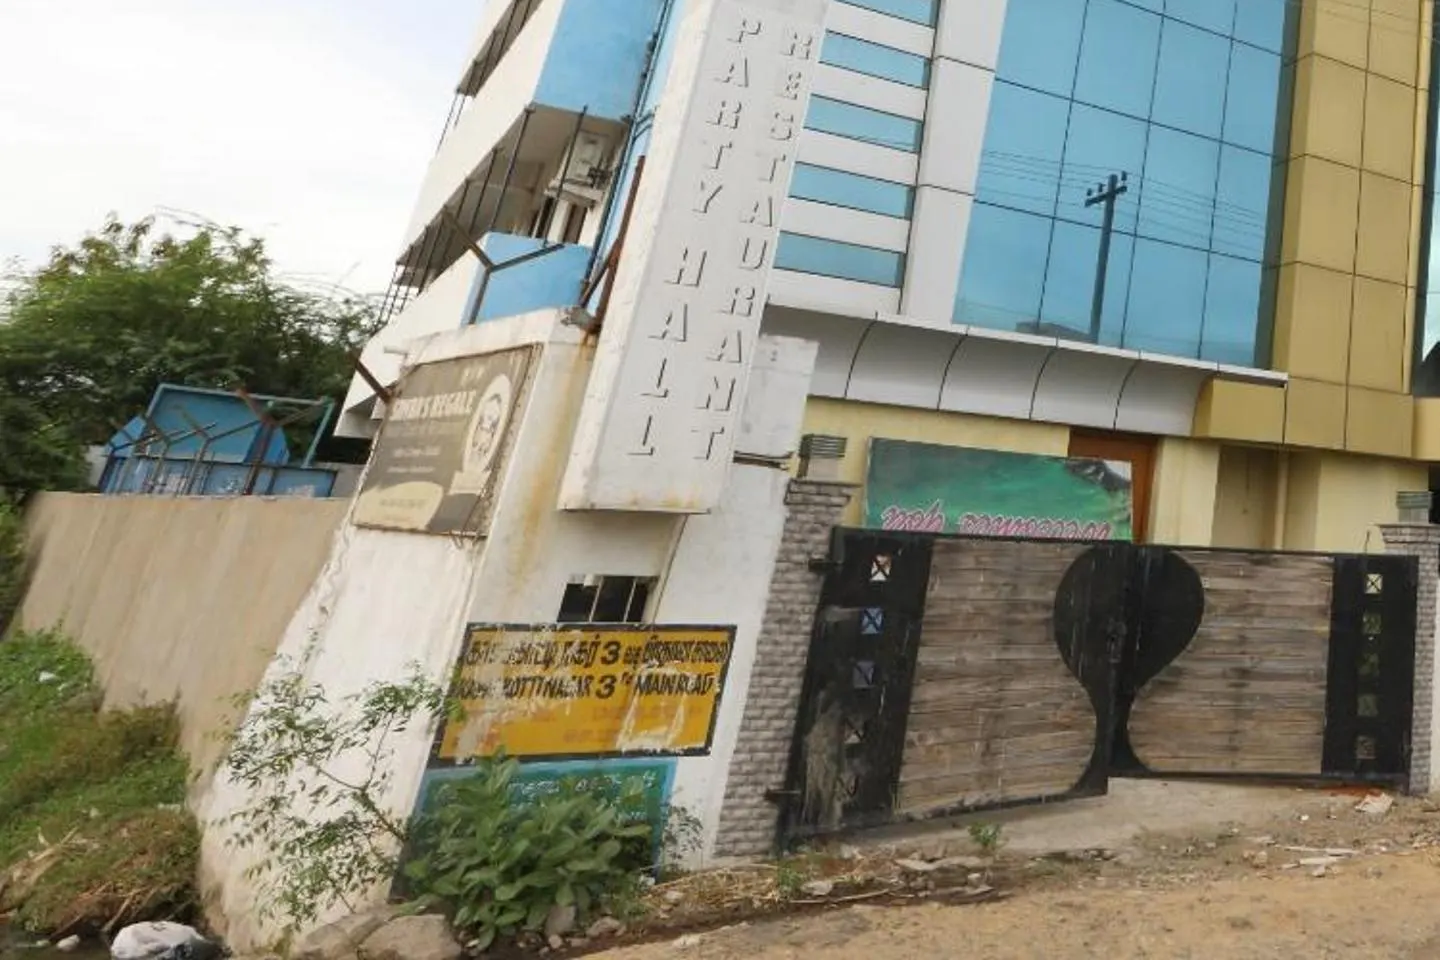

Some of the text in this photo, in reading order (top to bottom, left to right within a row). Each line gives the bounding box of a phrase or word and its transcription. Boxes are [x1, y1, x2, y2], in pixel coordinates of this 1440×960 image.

[626, 17, 763, 458] PARTY HALL
[690, 28, 815, 461] RESTAURANT
